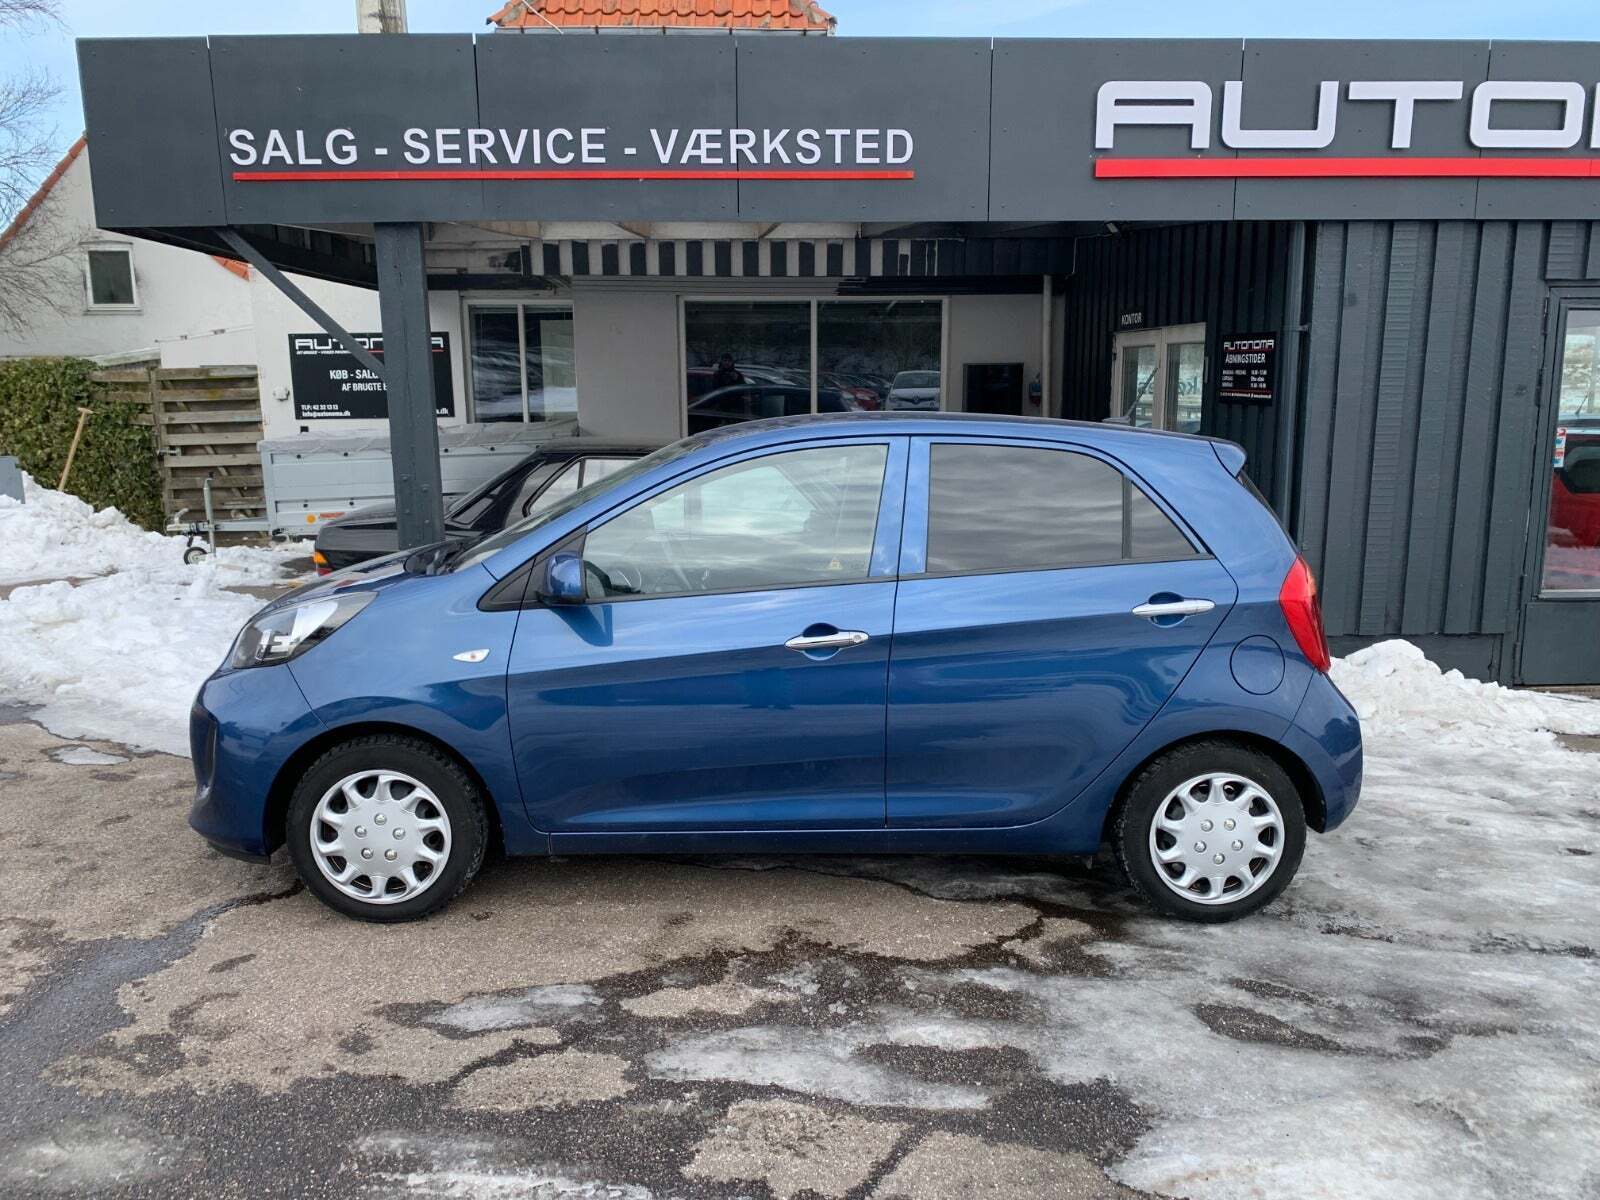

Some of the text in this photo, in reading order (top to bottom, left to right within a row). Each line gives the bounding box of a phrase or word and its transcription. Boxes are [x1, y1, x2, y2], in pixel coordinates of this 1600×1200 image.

[1095, 80, 1600, 149] AUTO
[229, 127, 914, 165] SALG - SERVICE - VÆRKSTED
[1121, 312, 1142, 325] KONTOR
[1223, 339, 1275, 351] AUTONOMA
[329, 369, 349, 380] KØB
[341, 383, 352, 391] AF
[352, 382, 382, 391] BRUGTE
